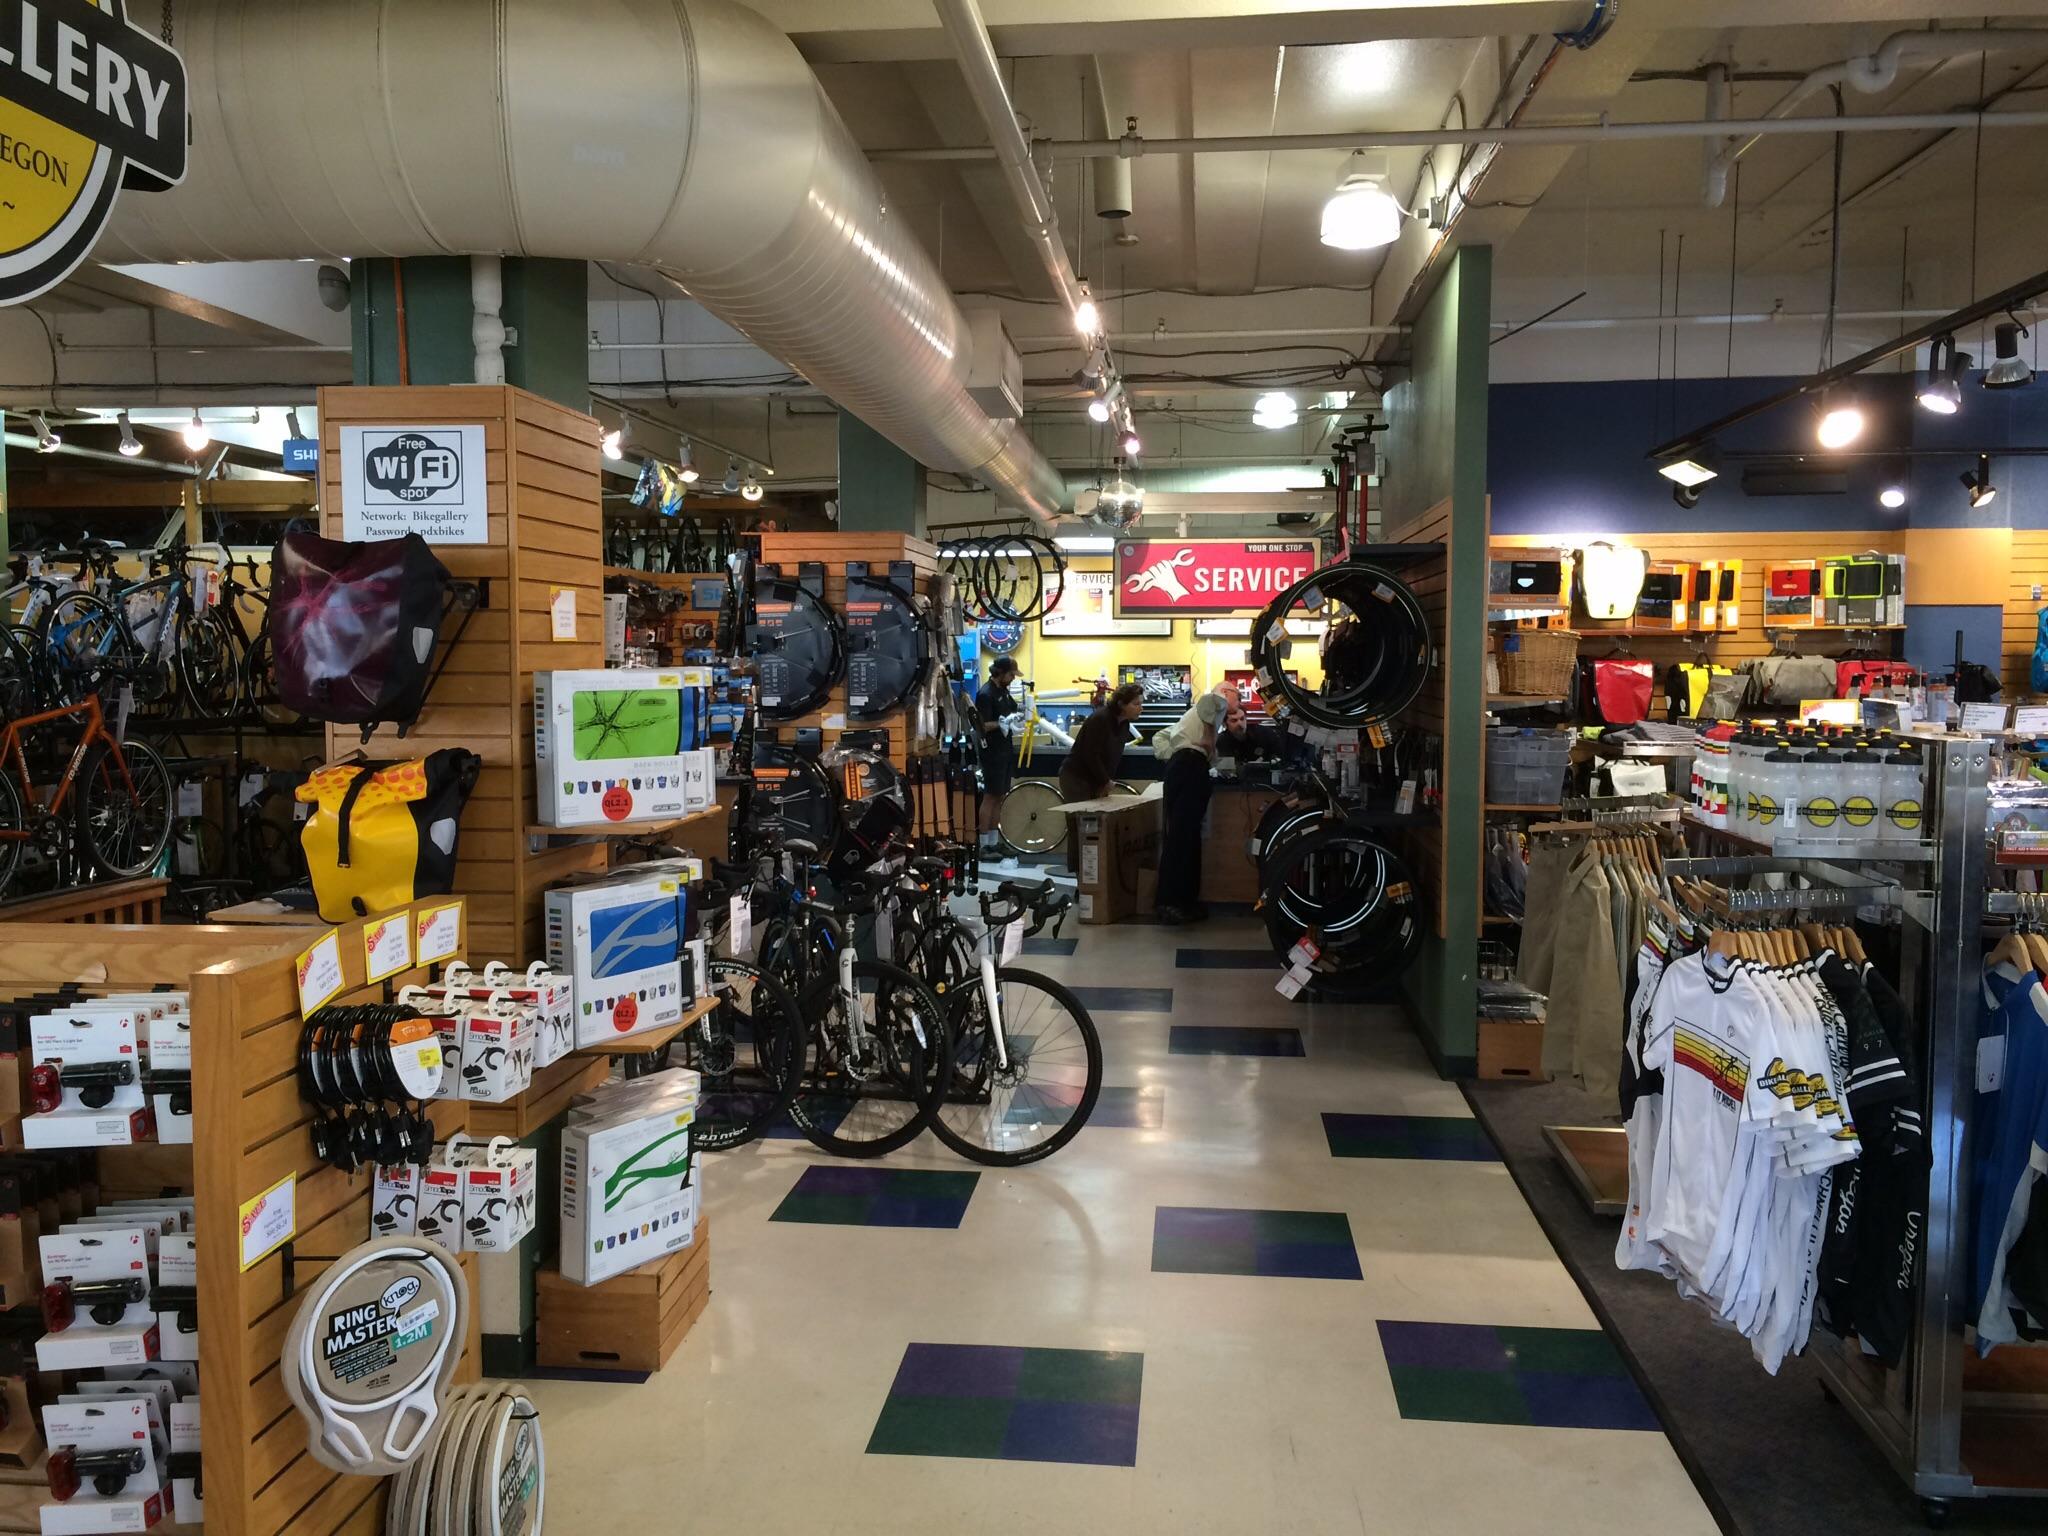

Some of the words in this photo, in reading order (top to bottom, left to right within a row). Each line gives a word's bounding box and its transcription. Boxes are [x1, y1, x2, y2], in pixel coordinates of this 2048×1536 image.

[0, 0, 170, 140] LERY
[398, 438, 426, 449] Free
[400, 488, 429, 500] spot
[361, 511, 407, 521] Network:
[413, 511, 469, 523] Bikegallery
[420, 526, 465, 537] pdxbikes
[1248, 544, 1266, 552] YOUR
[1269, 544, 1282, 552] ONE
[334, 1304, 377, 1332] RING
[327, 1312, 397, 1355] MASTER
